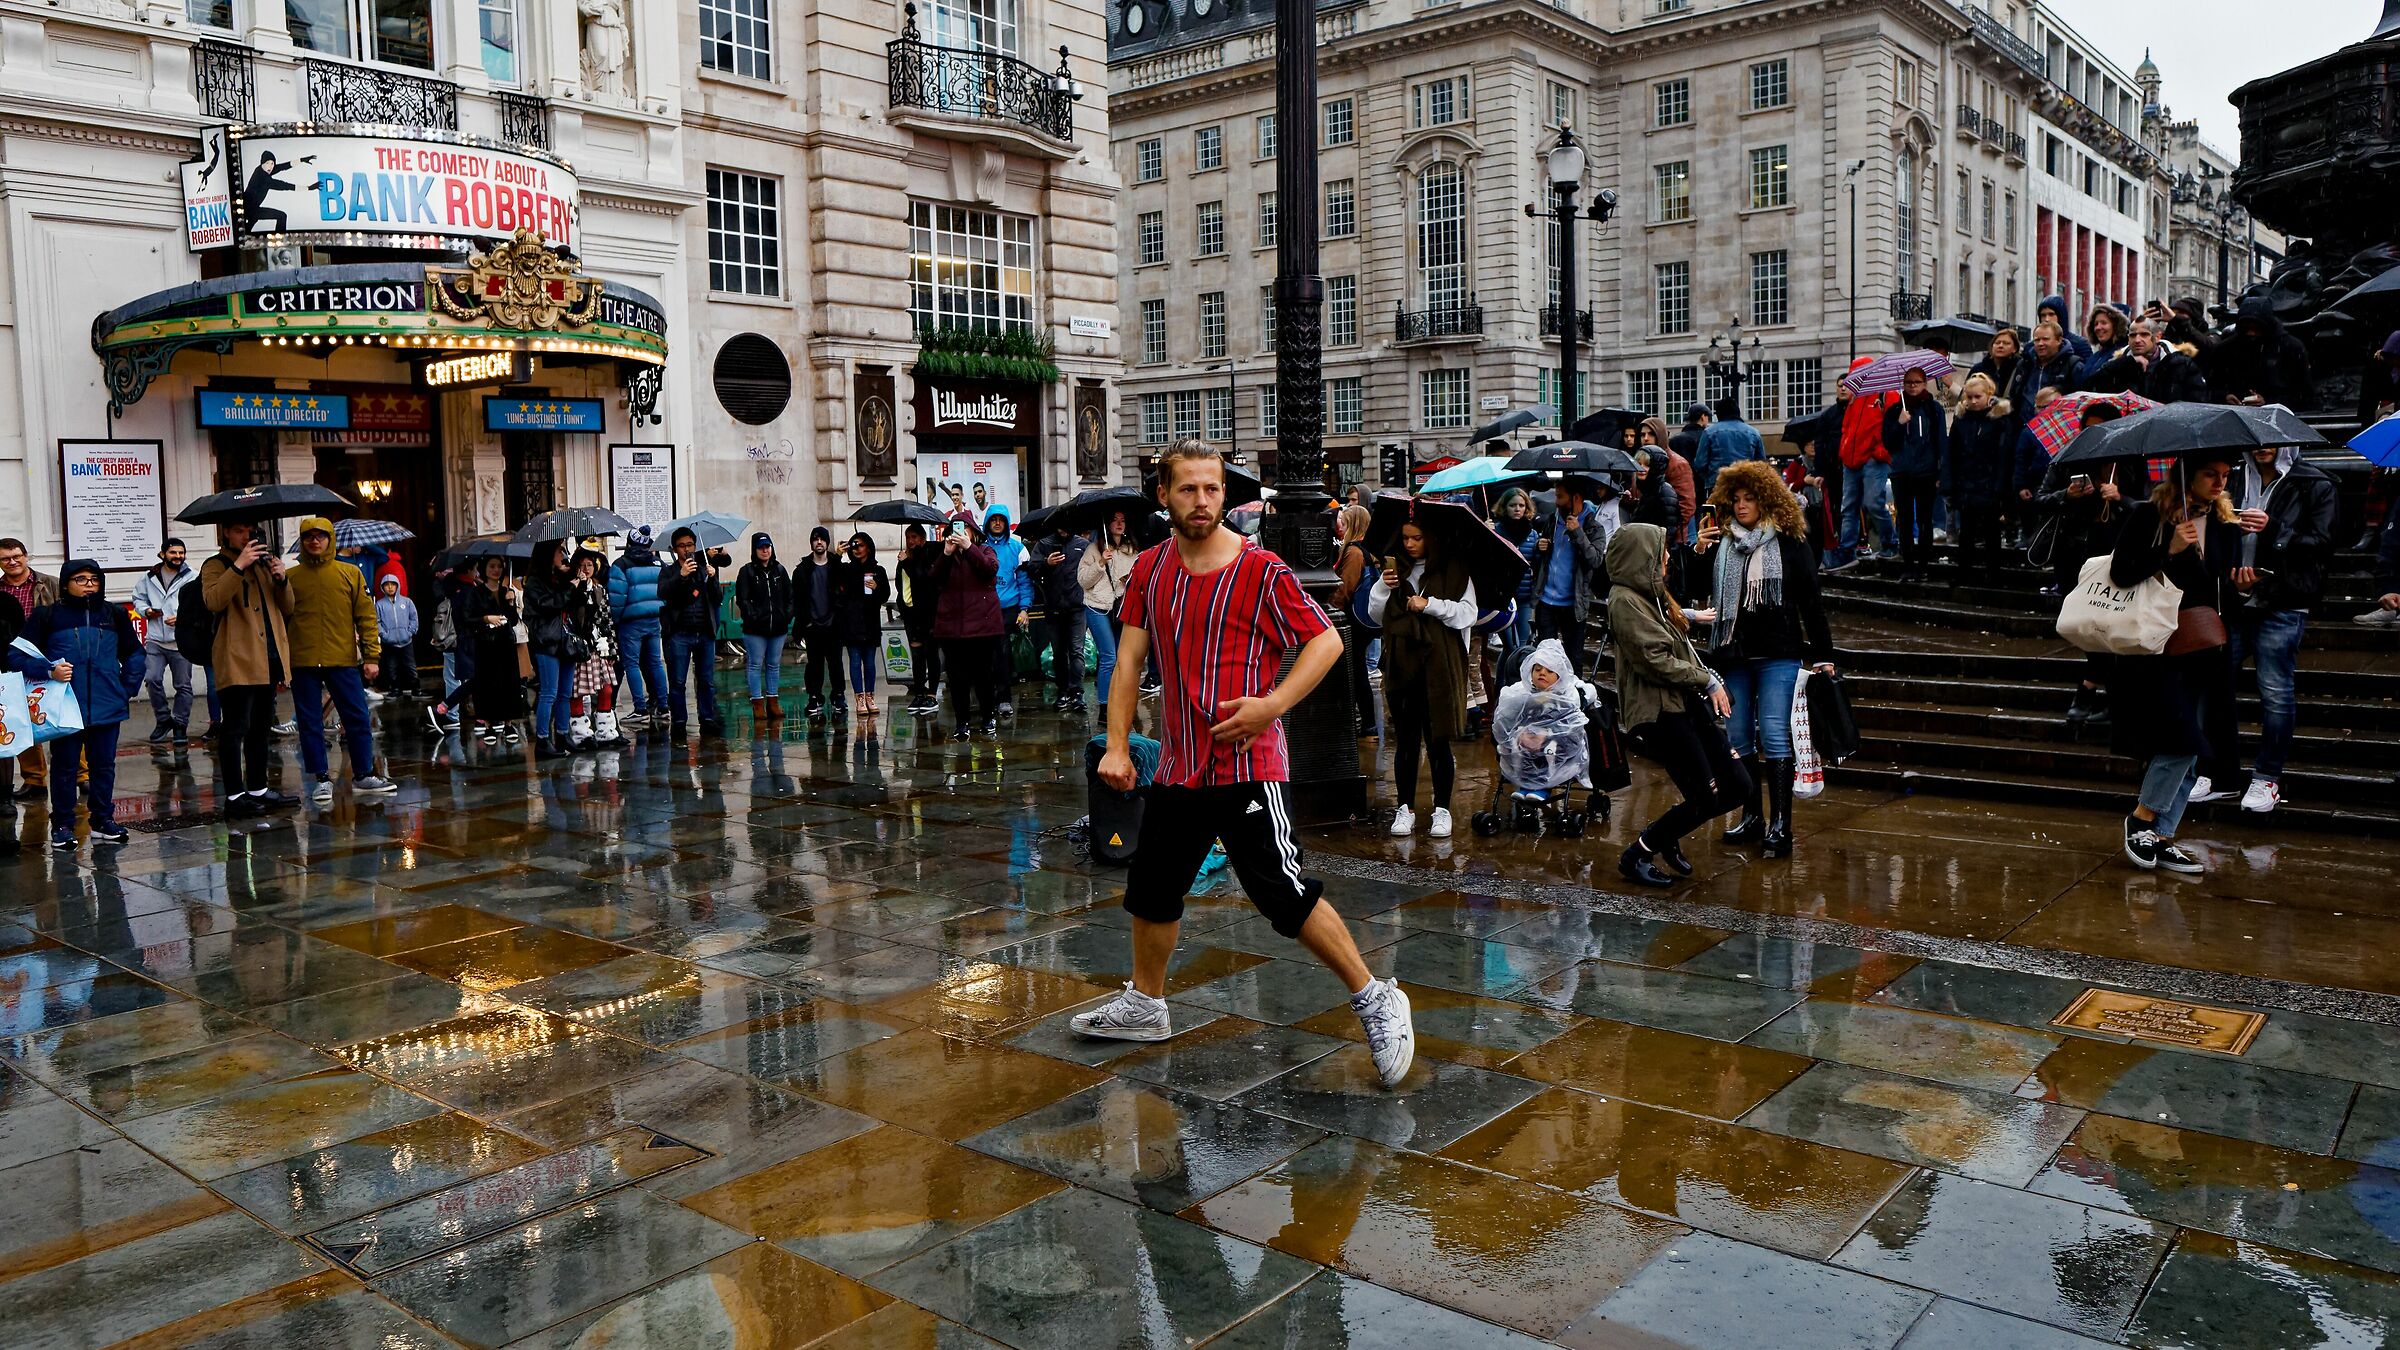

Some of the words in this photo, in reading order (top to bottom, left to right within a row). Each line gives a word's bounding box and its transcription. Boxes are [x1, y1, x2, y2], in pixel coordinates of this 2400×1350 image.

[374, 147, 413, 171] THE
[417, 150, 489, 179] COMEDY
[494, 160, 538, 187] ABOUT
[540, 170, 548, 191] A
[188, 201, 230, 230] BANK
[317, 171, 438, 224] BANK
[444, 178, 572, 245] ROBBERY
[191, 226, 231, 246] ROBBERY
[258, 285, 417, 311] CRITERION
[601, 297, 659, 333] THEATRE
[1073, 320, 1098, 328] PICCADILLY
[425, 351, 513, 386] CRITERION
[930, 385, 1018, 430] Lillywhites
[71, 464, 102, 476] BANK
[103, 464, 152, 476] ROBBERY
[2086, 582, 2136, 602] ITALIA
[2088, 600, 2111, 610] AMORE
